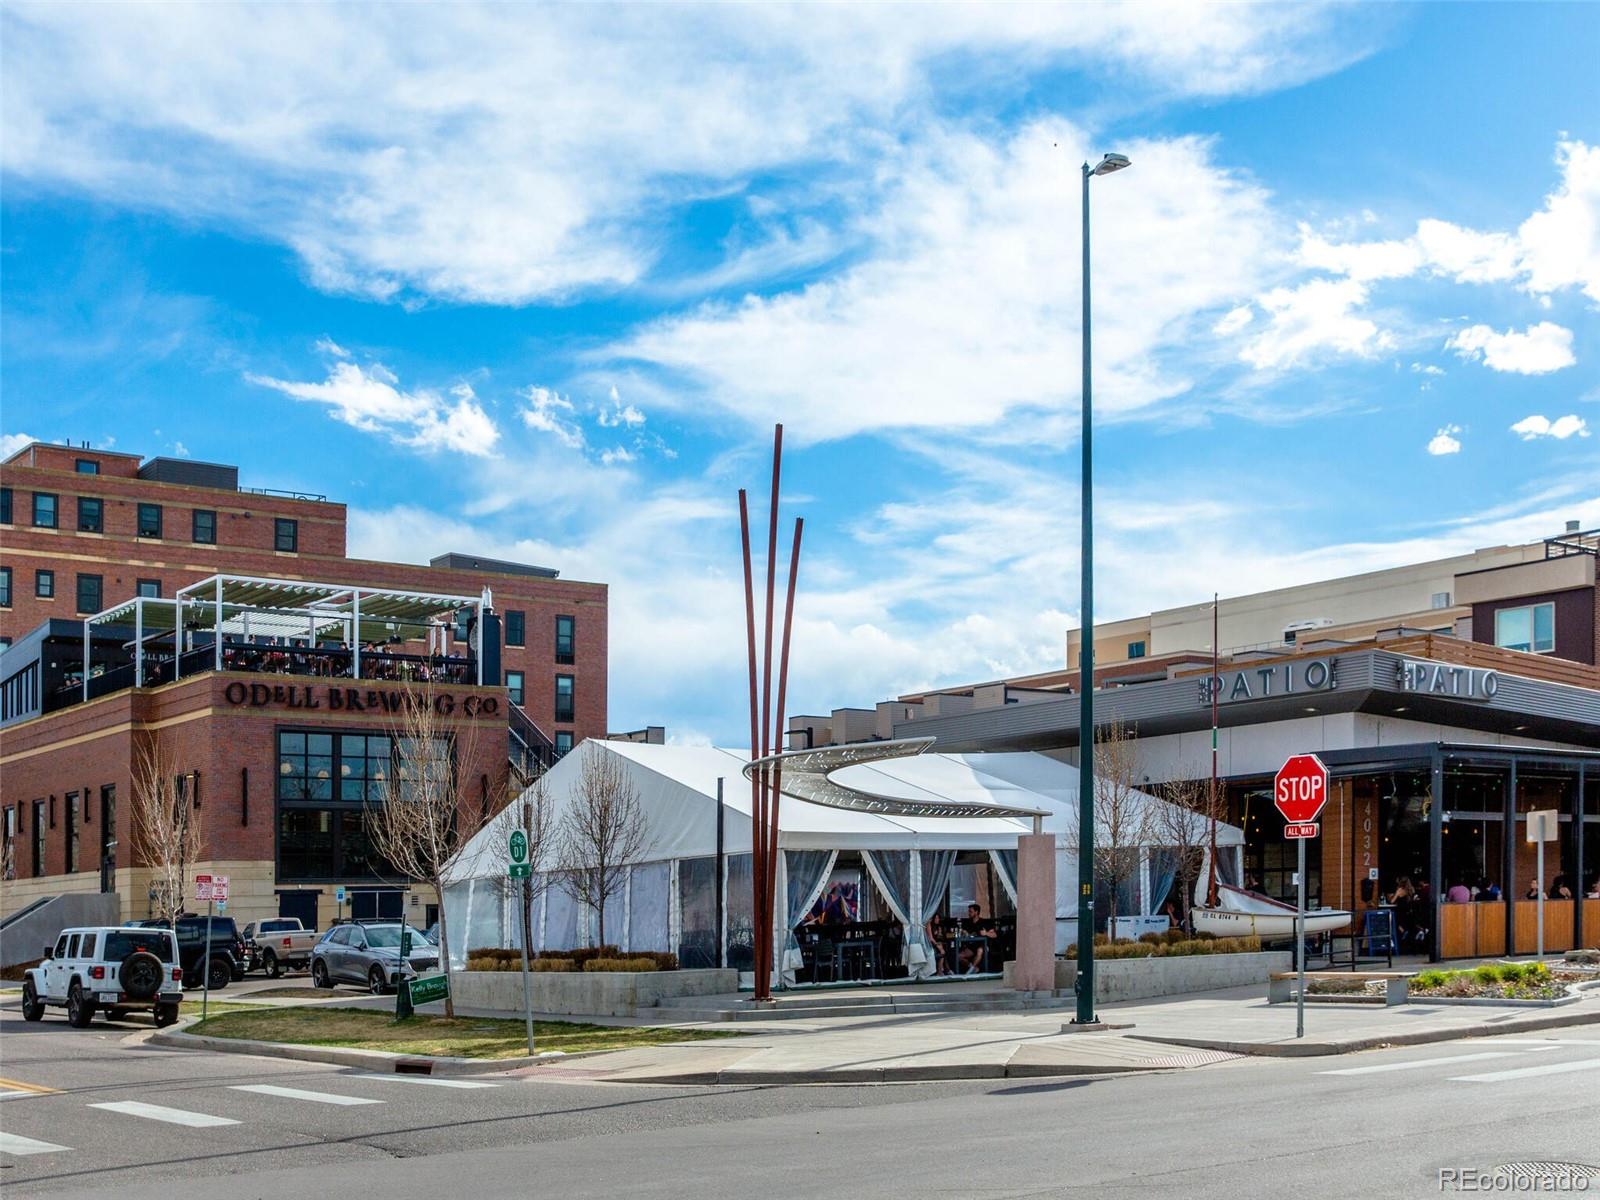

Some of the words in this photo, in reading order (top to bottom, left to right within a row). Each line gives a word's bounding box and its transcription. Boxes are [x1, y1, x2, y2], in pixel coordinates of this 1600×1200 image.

[225, 681, 319, 709] ODELL
[1208, 661, 1328, 702] PATIO
[1412, 662, 1498, 698] PATIO
[1279, 775, 1322, 802] STOP
[1287, 826, 1299, 836] ALL
[1300, 826, 1313, 835] WAY
[1363, 801, 1372, 866] 4032
